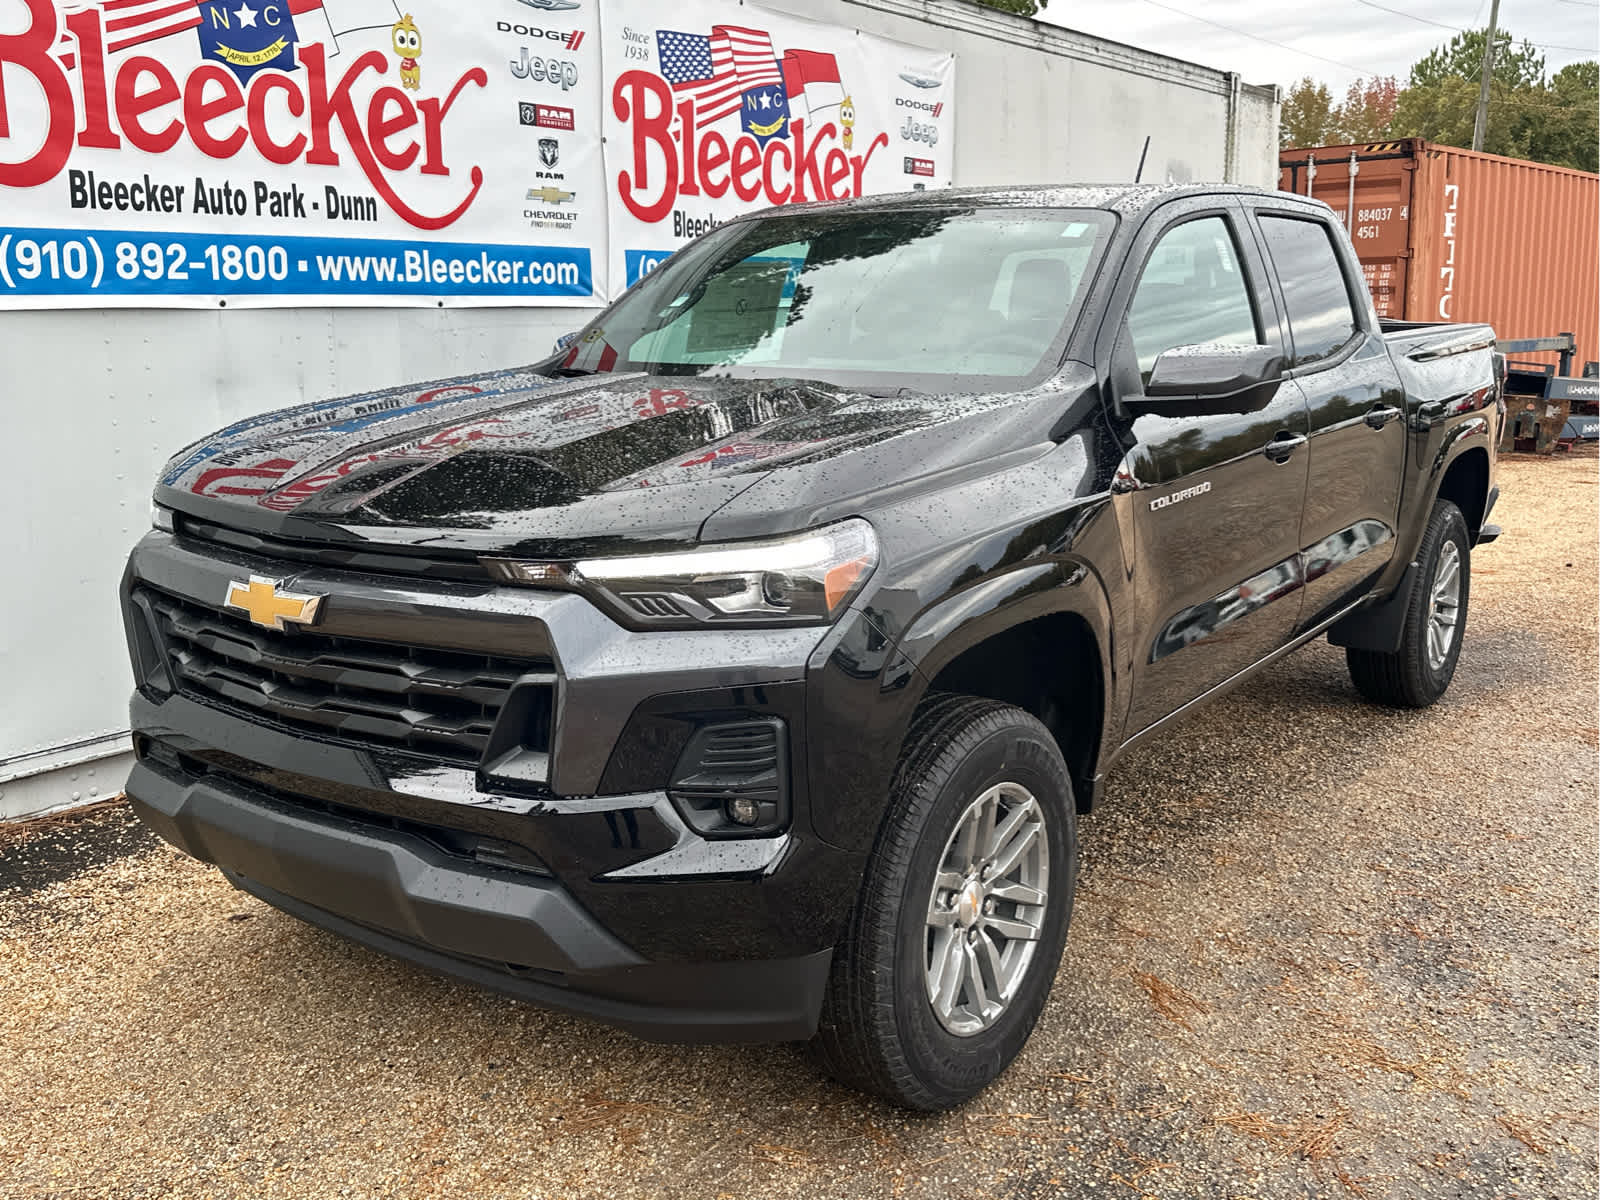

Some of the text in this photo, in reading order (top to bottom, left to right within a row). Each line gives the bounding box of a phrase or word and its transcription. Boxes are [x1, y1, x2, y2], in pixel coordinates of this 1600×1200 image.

[210, 6, 280, 29] N C
[497, 22, 573, 42] DODGE
[622, 27, 650, 44] Since
[625, 45, 649, 61] 1938
[510, 47, 578, 91] Jeep
[539, 108, 571, 120] RAM
[895, 98, 937, 112] DODGE
[900, 116, 938, 148] Jeep
[613, 70, 888, 223] Bleecker
[536, 171, 564, 180] RAM
[69, 170, 377, 221] Bleecker Auto Park Dunn
[523, 210, 578, 221] CHEVROLET
[673, 210, 723, 238] Bleeck
[1358, 207, 1392, 222] 884037
[1357, 224, 1379, 239] 45G1
[0, 234, 579, 288] (910) 892-1800 www.Bleecker.com
[1149, 481, 1211, 512] COLORADO
